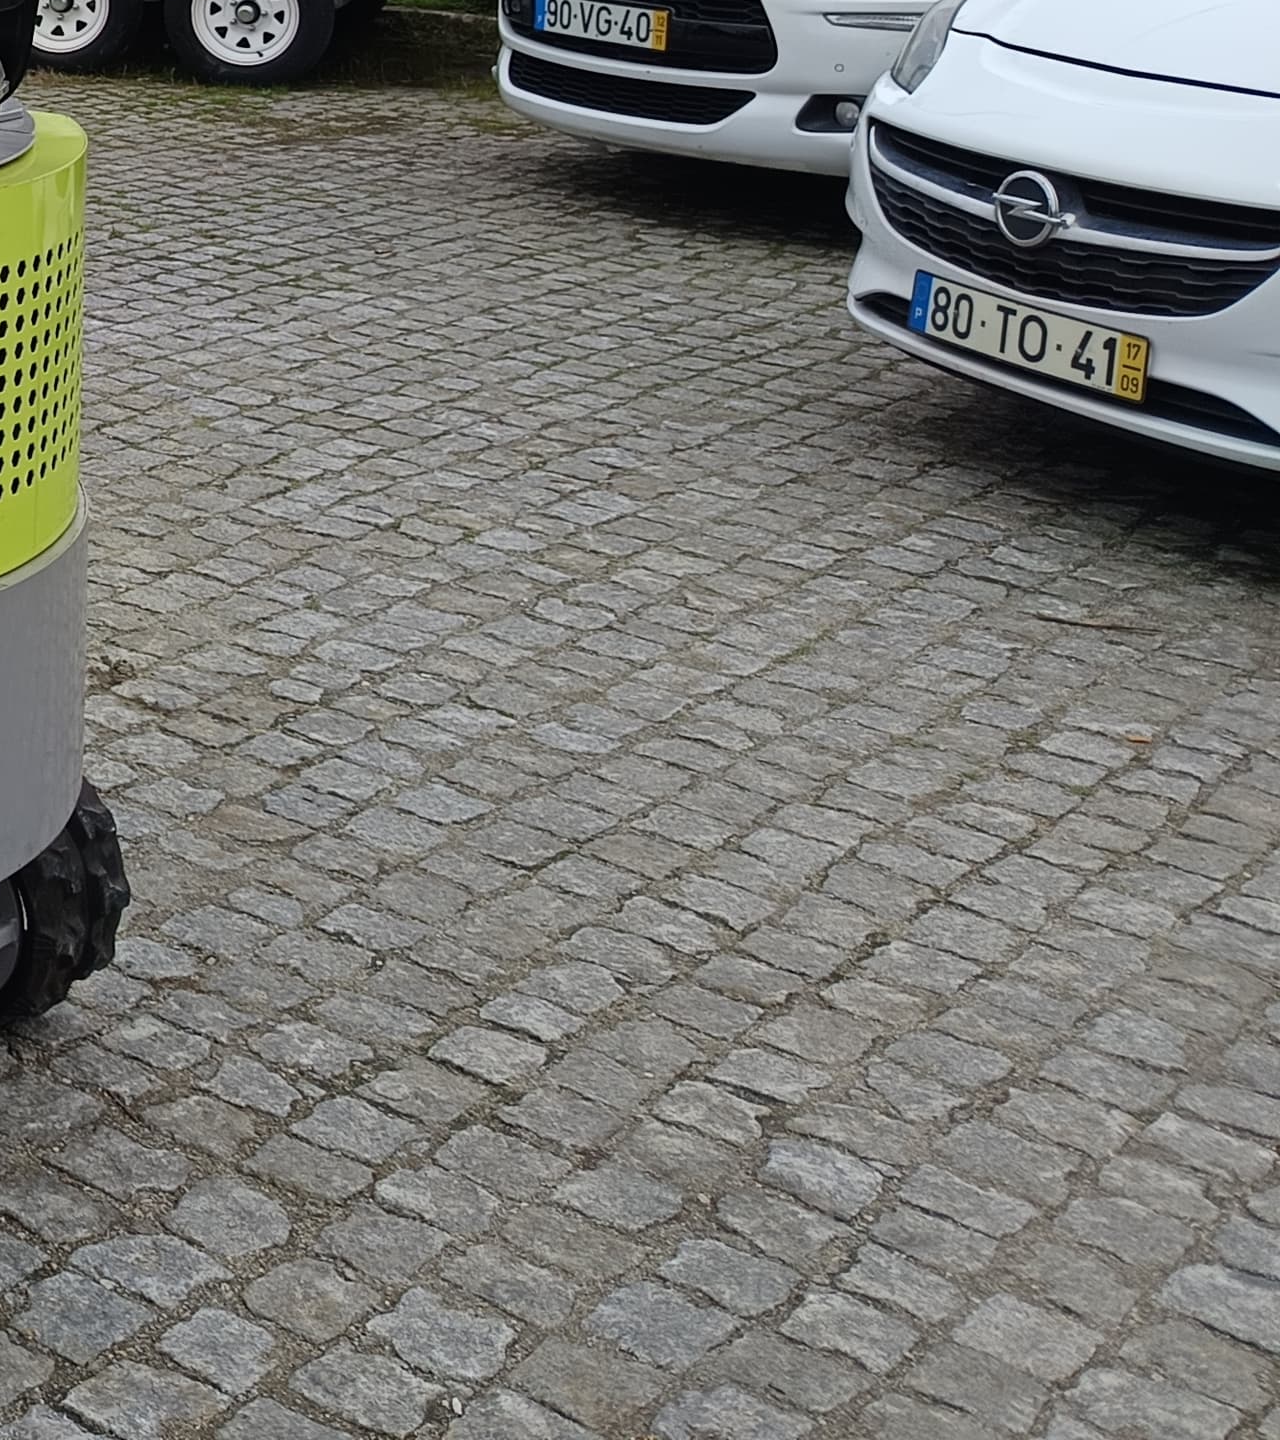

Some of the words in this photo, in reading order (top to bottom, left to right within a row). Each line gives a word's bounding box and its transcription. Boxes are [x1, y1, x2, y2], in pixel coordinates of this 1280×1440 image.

[915, 307, 923, 319] P
[1125, 342, 1142, 361] 17
[1120, 374, 1139, 394] 09
